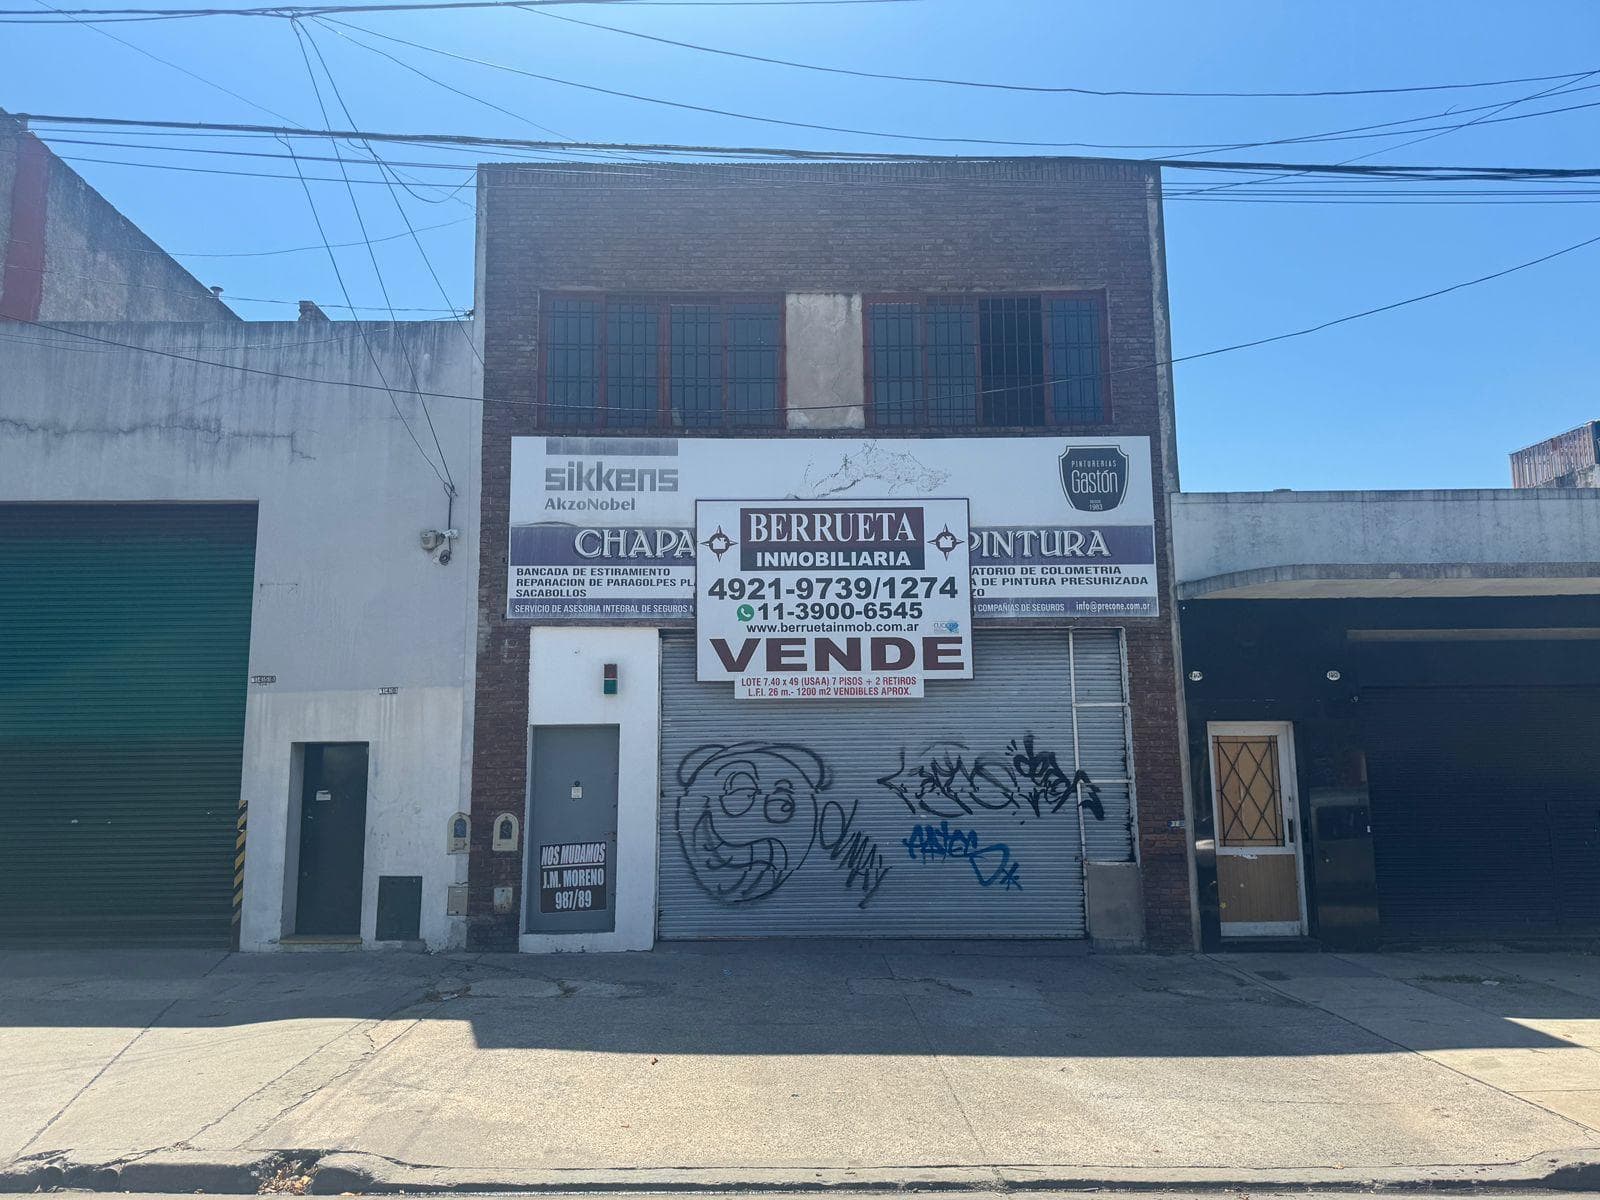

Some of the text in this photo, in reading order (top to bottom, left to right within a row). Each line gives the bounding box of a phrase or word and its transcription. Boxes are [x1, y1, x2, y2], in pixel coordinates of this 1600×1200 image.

[1071, 460, 1117, 468] PINTURERIAS
[545, 461, 679, 492] sikkens
[1071, 469, 1118, 494] Gastón
[544, 497, 636, 511] AkzoNobel
[748, 512, 916, 543] BERRUETA
[574, 528, 696, 559] CHAPA
[970, 529, 1112, 559] PINTURA
[756, 551, 911, 567] INMOBILIARIA
[516, 567, 671, 576] BANCADA DE ESTIRAMIENTO
[971, 566, 1122, 576] ATORIO DE COLOMETRIA
[516, 578, 696, 587] REPARACION DE PARAGOLPES PL
[708, 576, 958, 601] 4921-9739/1274
[981, 577, 998, 586] DE
[1002, 577, 1056, 586] PINTURA
[1061, 576, 1149, 585] PRESURIZADA
[515, 589, 587, 598] SACABOLLOS
[514, 604, 550, 613] SERVICIO
[551, 604, 562, 613] DE
[563, 604, 600, 613] ASESORIA
[602, 604, 640, 613] INTEGRAL
[641, 604, 652, 613] DE
[653, 604, 688, 613] SEGUROS
[757, 602, 923, 620] 11-3900-6545
[1020, 604, 1031, 612] DE
[1031, 603, 1065, 612] SEGUROS
[746, 621, 919, 633] www.berruetainmob.com.ar
[709, 636, 965, 672] VENDE
[741, 677, 761, 687] LOTE
[764, 677, 780, 686] 7.40
[789, 677, 799, 686] 49
[801, 676, 830, 687] (USAA)
[832, 676, 837, 686] 7
[839, 676, 863, 686] PISOS
[875, 676, 881, 685] 2
[882, 676, 917, 686] RETIROS
[768, 687, 779, 696] 26
[797, 687, 817, 696] 1200
[818, 687, 831, 696] m2
[833, 687, 879, 696] VENDIBLES
[880, 687, 912, 696] APROX.
[541, 843, 606, 866] NOS MUDAMOS
[542, 868, 604, 889] J.M. MORENO
[555, 889, 592, 910] 987/89
